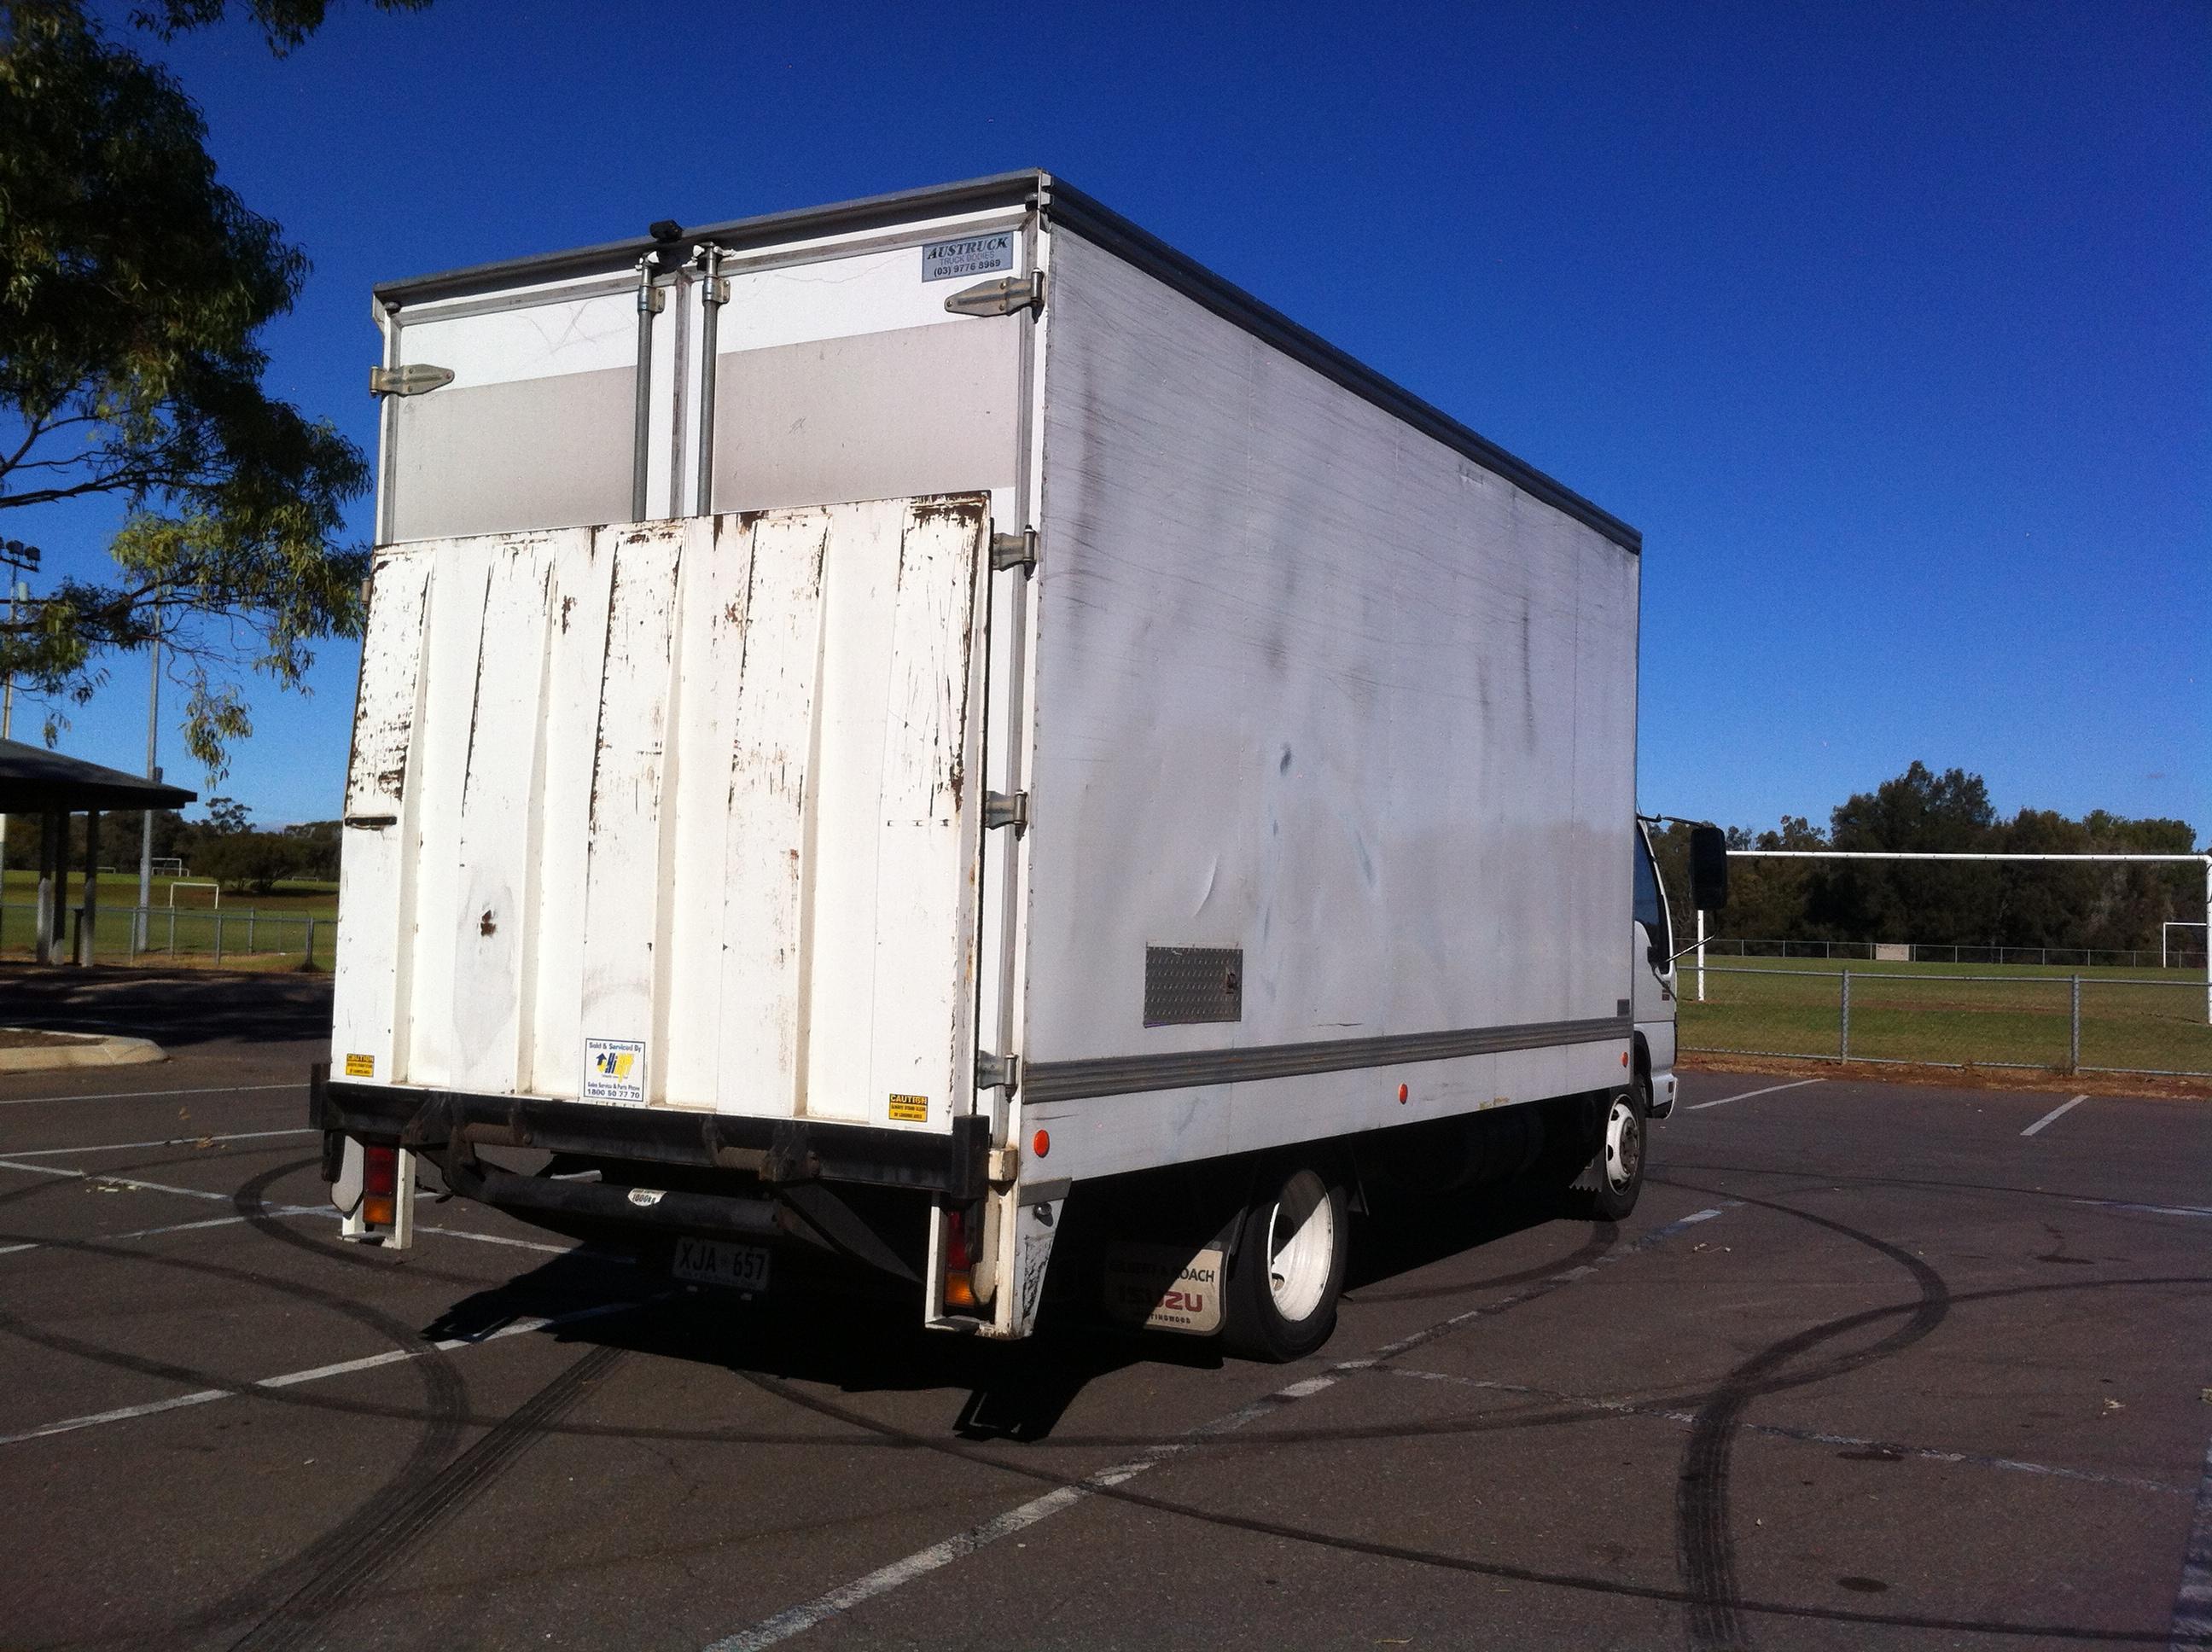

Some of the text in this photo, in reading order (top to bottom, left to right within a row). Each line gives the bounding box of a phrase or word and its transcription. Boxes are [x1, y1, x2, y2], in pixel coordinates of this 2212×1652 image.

[927, 237, 1008, 260] AUSTRUCK
[940, 255, 964, 266] TRUCK
[934, 265, 952, 277] (03)
[953, 262, 976, 273] 9776
[608, 1043, 633, 1051] Serviced
[890, 1095, 927, 1104] CAUTION
[679, 1242, 716, 1272] XJA
[733, 1251, 765, 1281] 657
